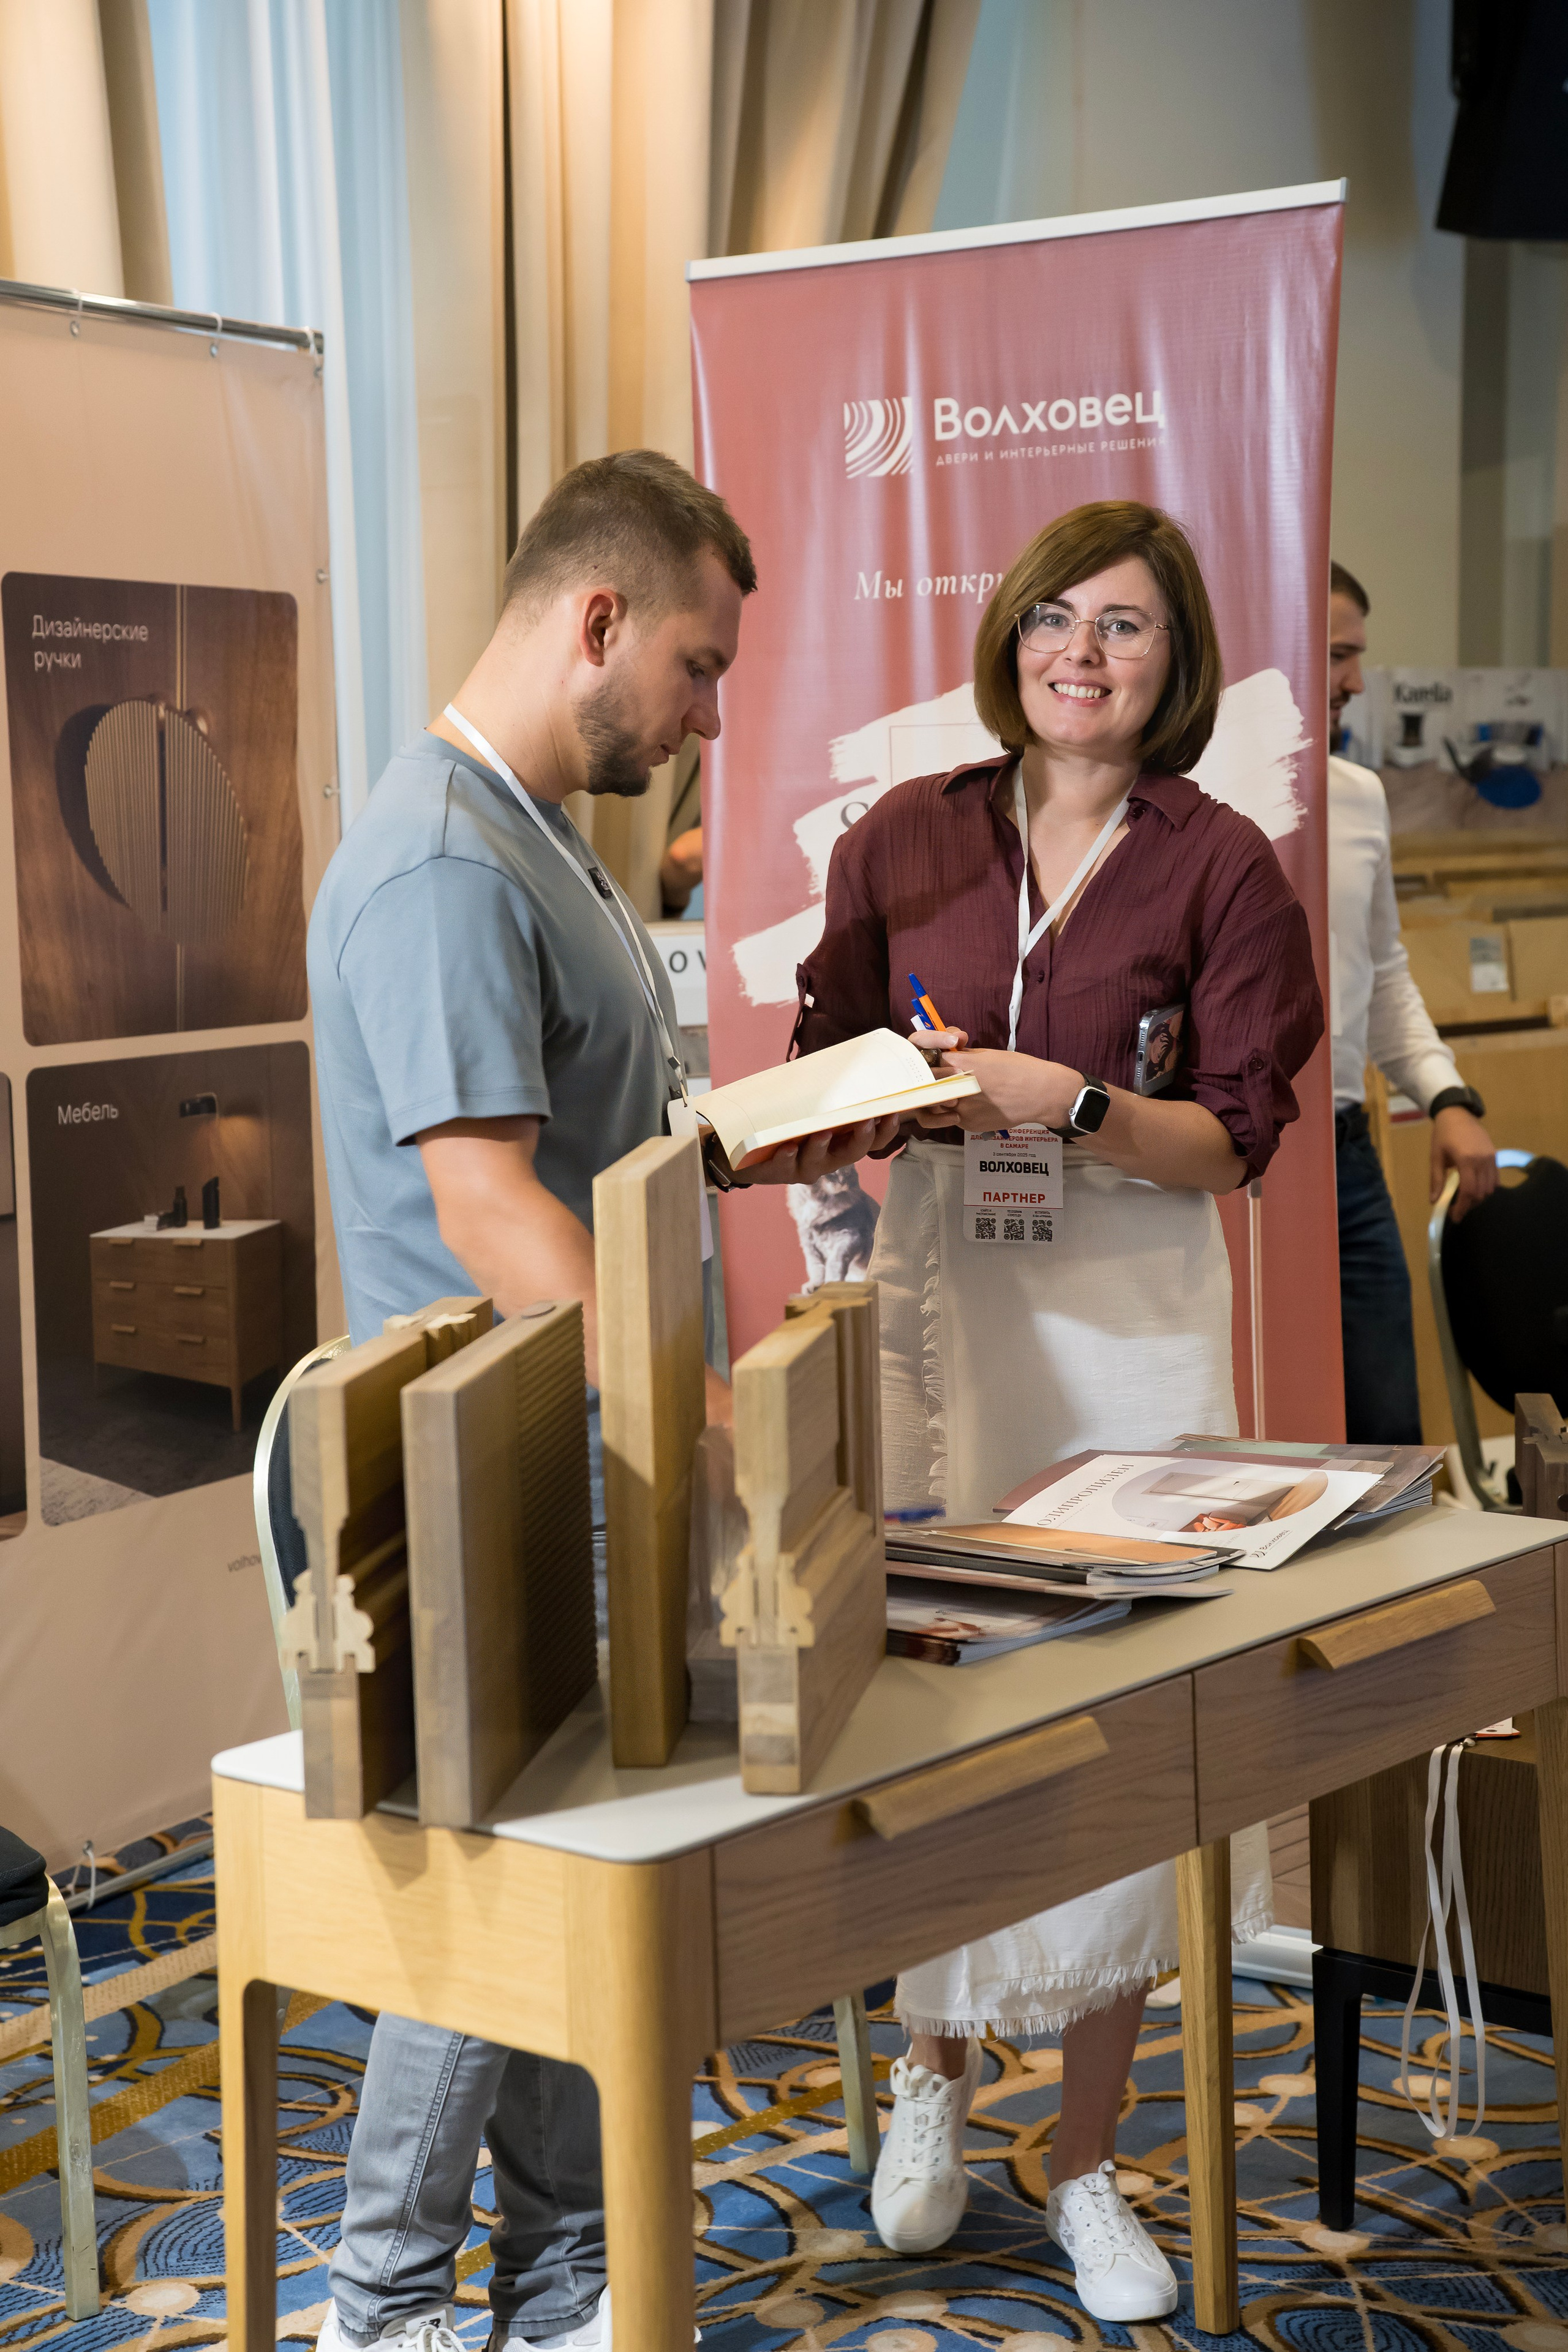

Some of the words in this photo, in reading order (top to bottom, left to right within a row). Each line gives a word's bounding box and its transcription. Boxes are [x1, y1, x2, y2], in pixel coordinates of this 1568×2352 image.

[934, 390, 1165, 441] Волховец
[936, 452, 979, 466] ДВЕРИ
[984, 450, 993, 461] И
[1000, 442, 1095, 459] ИНТЕРЬЕРНЫЕ
[1101, 436, 1166, 452] РЕШЕНИЯ
[853, 570, 903, 600] Мы
[32, 614, 149, 644] Дизайнерские
[34, 650, 82, 673] ручки
[58, 1102, 119, 1125] Мебель
[979, 1161, 1049, 1176] ВОЛХОВЕЦ
[983, 1191, 1046, 1204] ПАРТНЕР
[1037, 1464, 1134, 1526] ОЛИПРОПИЛЕН
